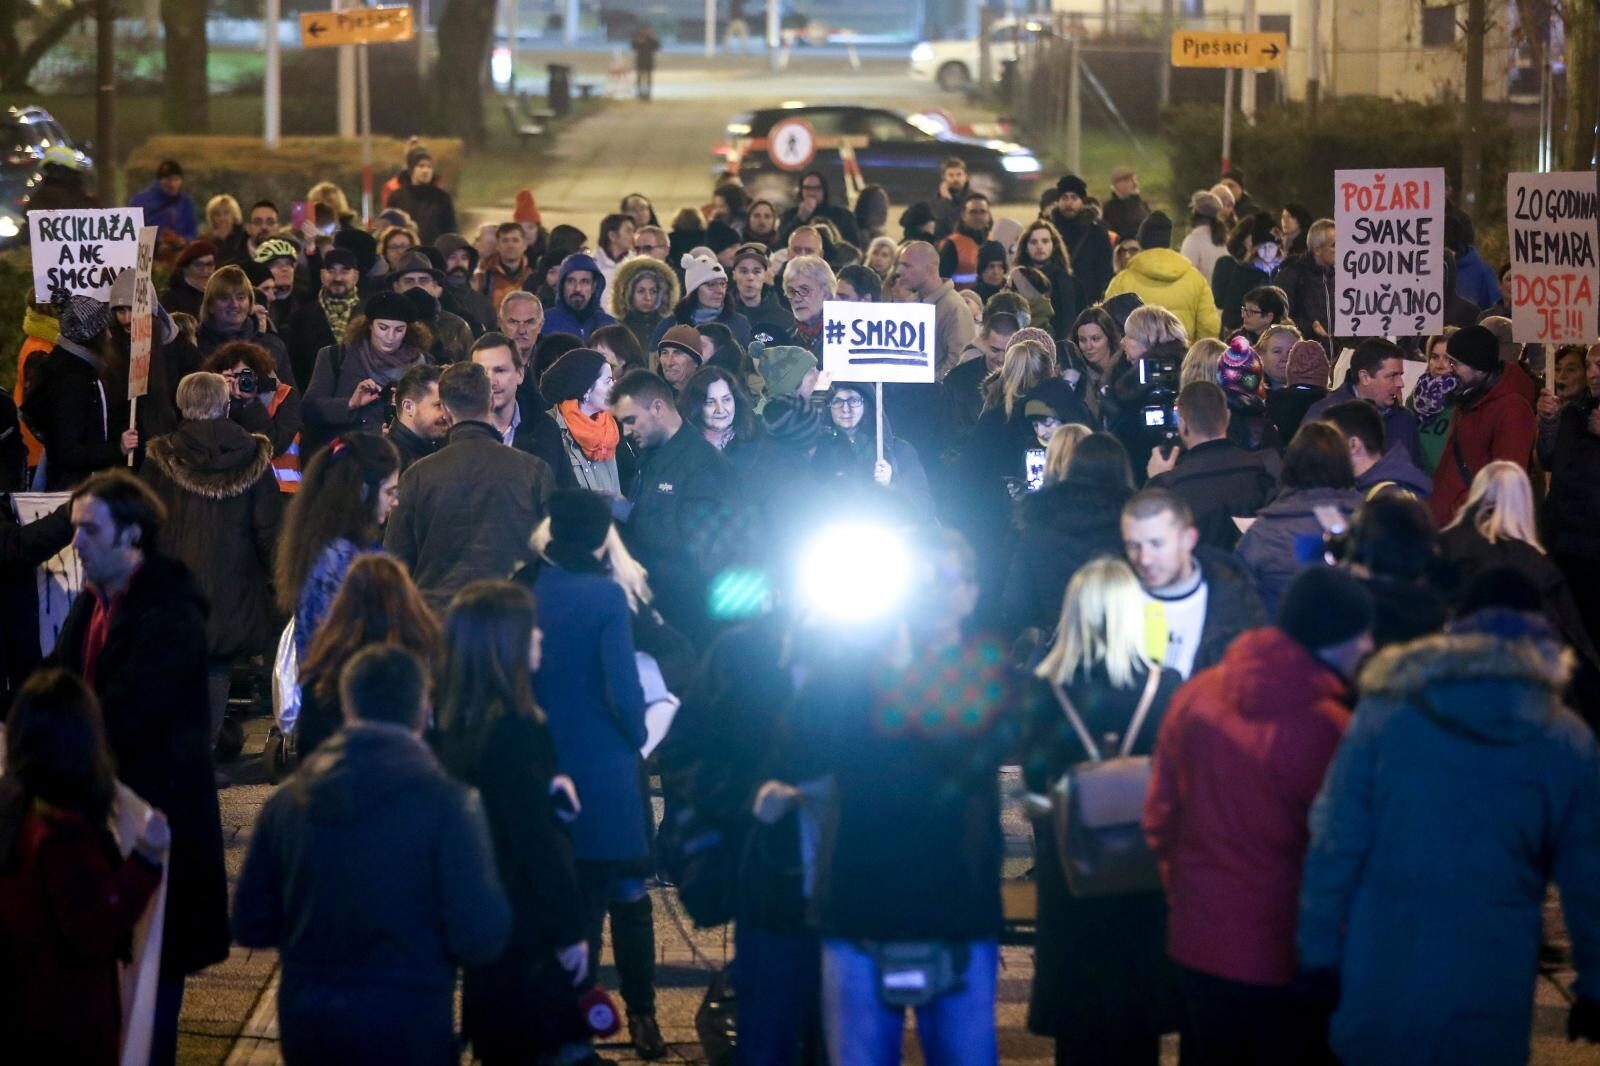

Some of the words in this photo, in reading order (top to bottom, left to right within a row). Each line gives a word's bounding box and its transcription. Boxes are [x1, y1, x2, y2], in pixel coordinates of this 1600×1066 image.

[1340, 174, 1431, 212] POŽARI
[1515, 186, 1542, 221] 20
[1545, 188, 1598, 224] GODINA
[38, 214, 137, 242] RECIKLAŽA
[1351, 217, 1433, 246] SVAKE
[59, 244, 74, 265] A
[79, 243, 106, 265] NE
[1343, 249, 1432, 279] GODINE
[1514, 229, 1596, 267] NEMARA
[1339, 283, 1441, 316] SLUČAJNO
[1513, 274, 1592, 307] DOSTA
[825, 318, 926, 352] #SMRDI
[1536, 308, 1583, 339] JE!!!
